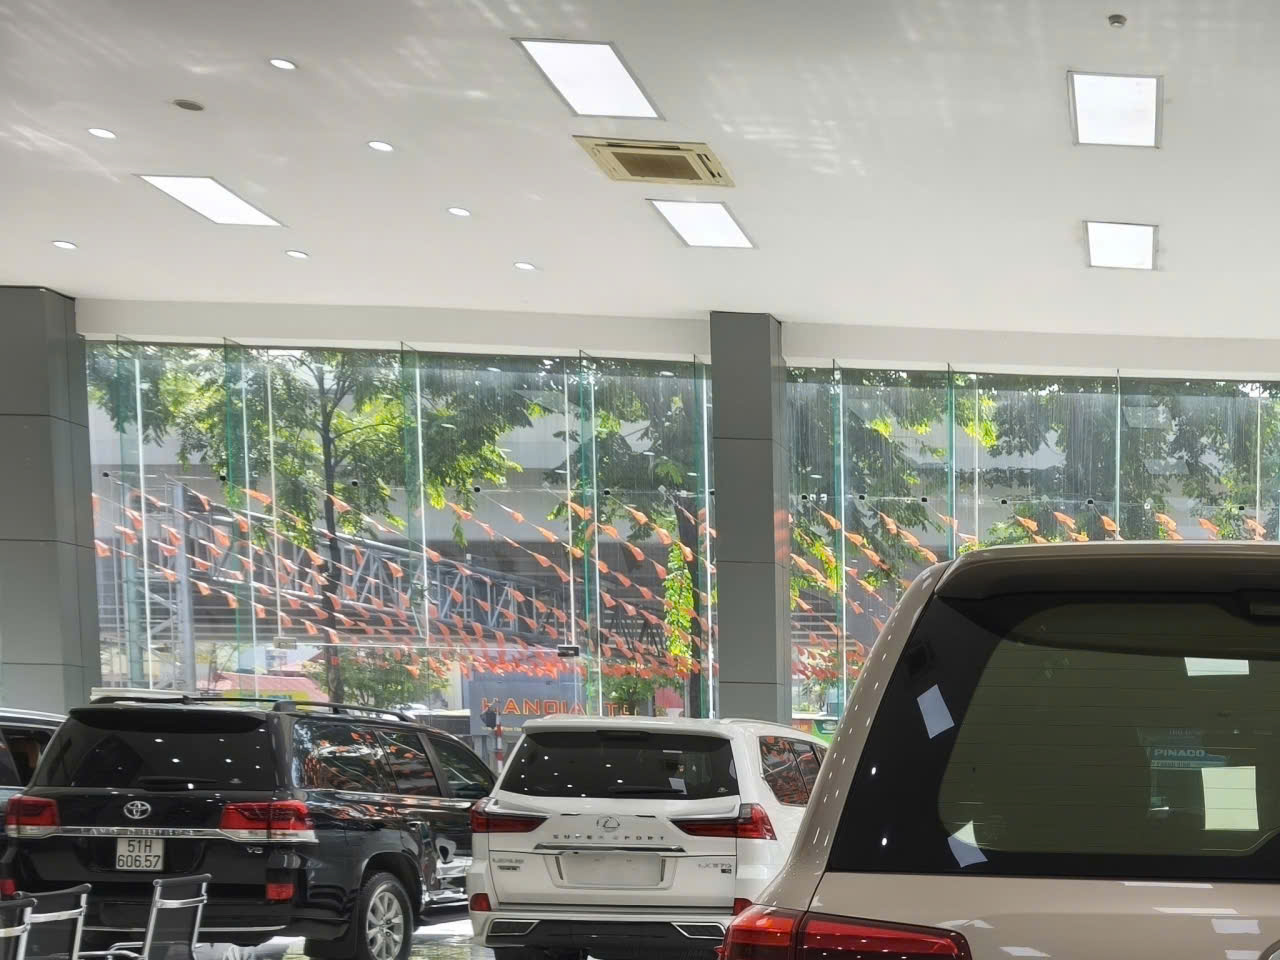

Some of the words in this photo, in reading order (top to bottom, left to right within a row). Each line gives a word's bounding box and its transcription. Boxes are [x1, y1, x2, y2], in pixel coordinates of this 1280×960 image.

[1154, 748, 1206, 757] PINACO
[127, 839, 153, 853] 51H
[117, 855, 161, 868] 606.57
